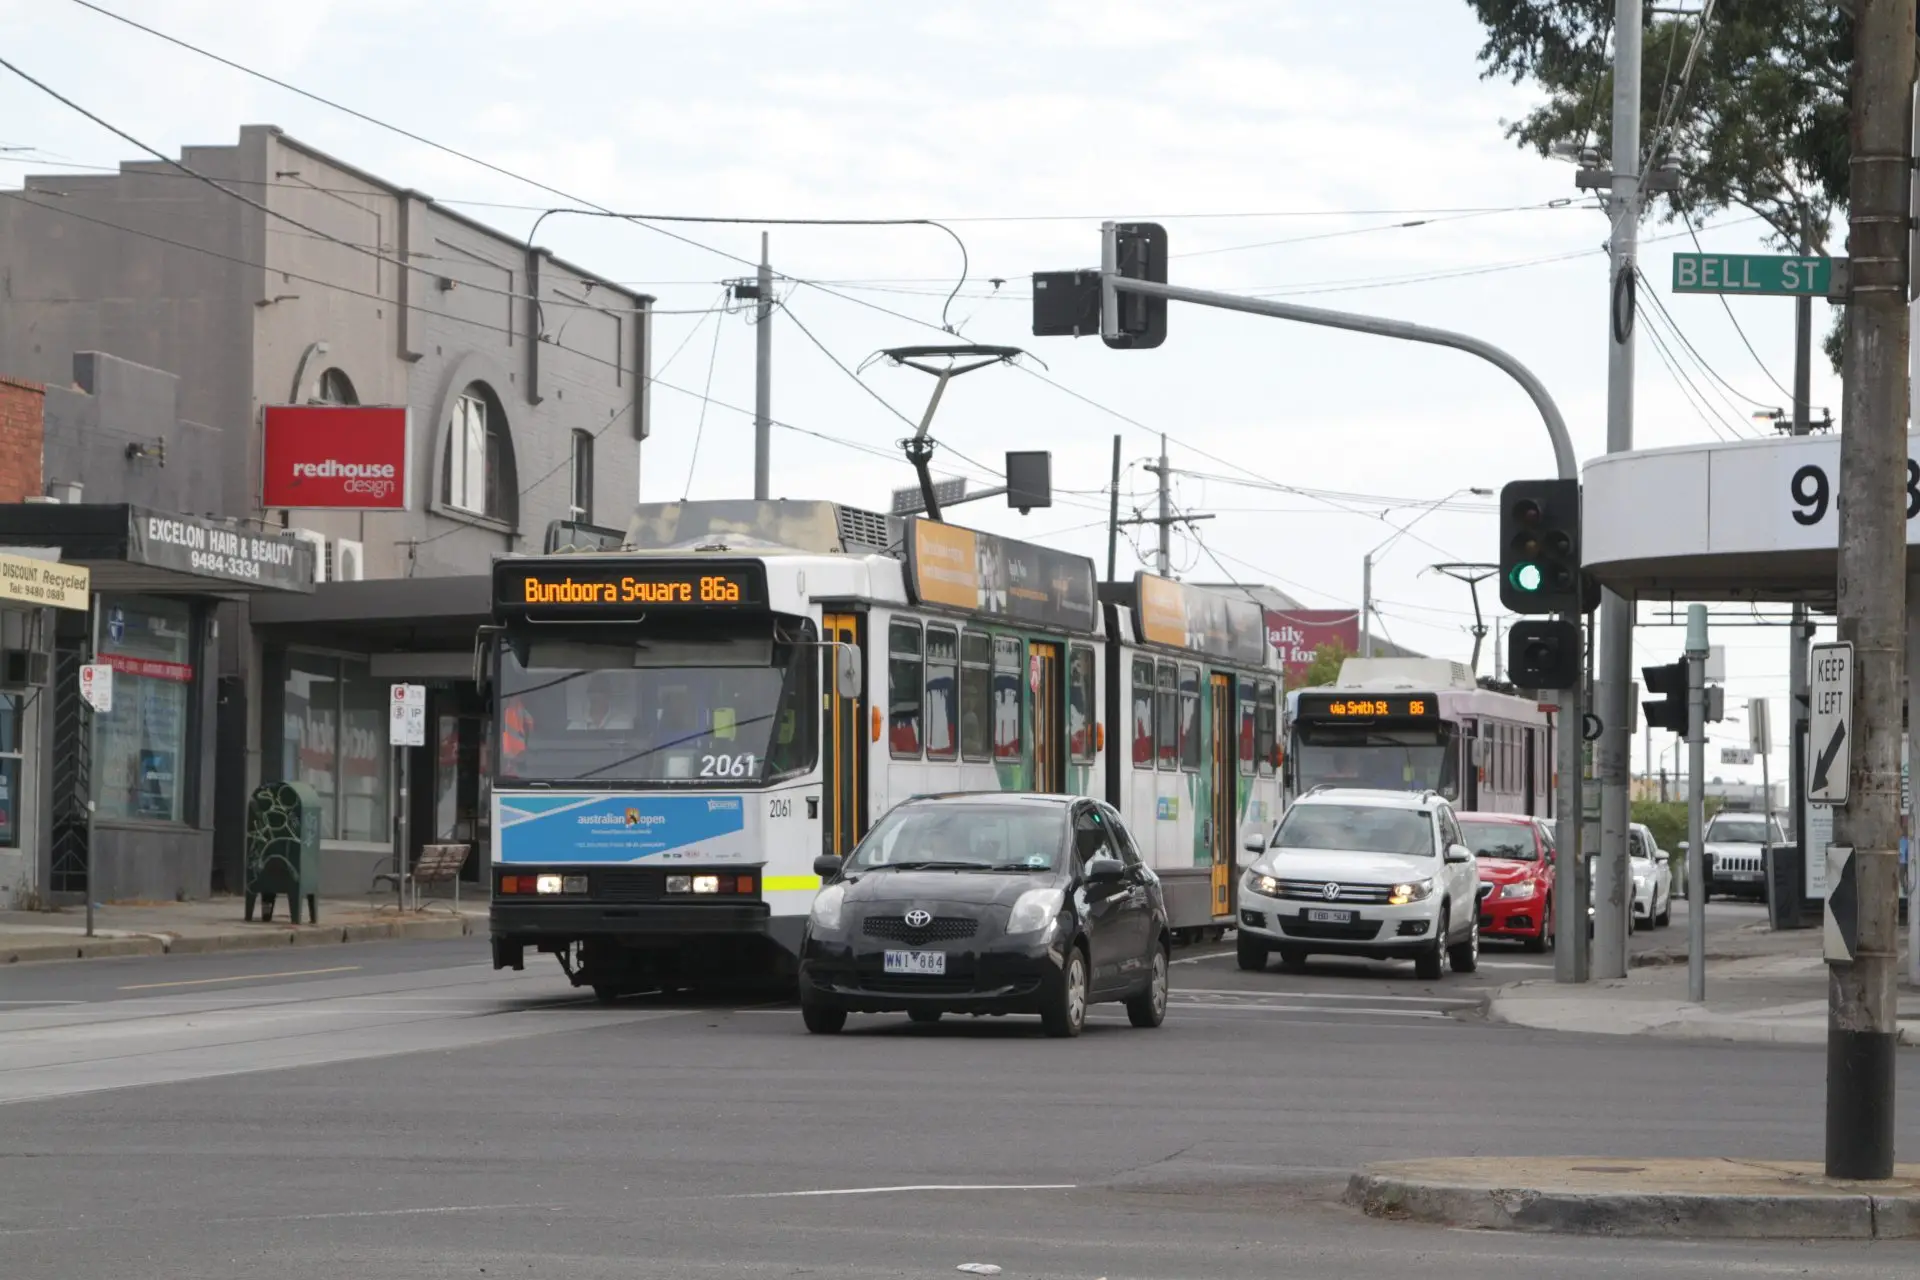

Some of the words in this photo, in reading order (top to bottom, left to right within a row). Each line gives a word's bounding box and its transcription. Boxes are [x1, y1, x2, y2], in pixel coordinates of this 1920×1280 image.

[1678, 258, 1761, 287] BELL
[1781, 260, 1820, 290] ST
[293, 459, 395, 478] redhouse
[343, 476, 395, 498] design
[149, 517, 205, 549] EXCELON
[209, 529, 238, 556] HAIR
[241, 538, 248, 559] &
[251, 540, 294, 566] BEAUTY
[2, 563, 38, 582] DISCOUNT
[43, 570, 87, 591] Recycled
[525, 577, 617, 602] Bundoora
[621, 577, 693, 602] Square
[700, 577, 739, 602] 86a
[1290, 646, 1317, 662] for
[1818, 658, 1845, 682] KEEP
[1330, 701, 1346, 714] via
[1347, 701, 1374, 715] Smith
[1376, 701, 1389, 714] St
[1409, 701, 1425, 715] 86
[1818, 691, 1843, 715] LEFT
[700, 754, 755, 777] 2061
[769, 799, 792, 818] 2061
[577, 813, 625, 825] australian
[640, 815, 665, 828] open
[886, 953, 909, 968] WNI
[920, 955, 943, 969] 884
